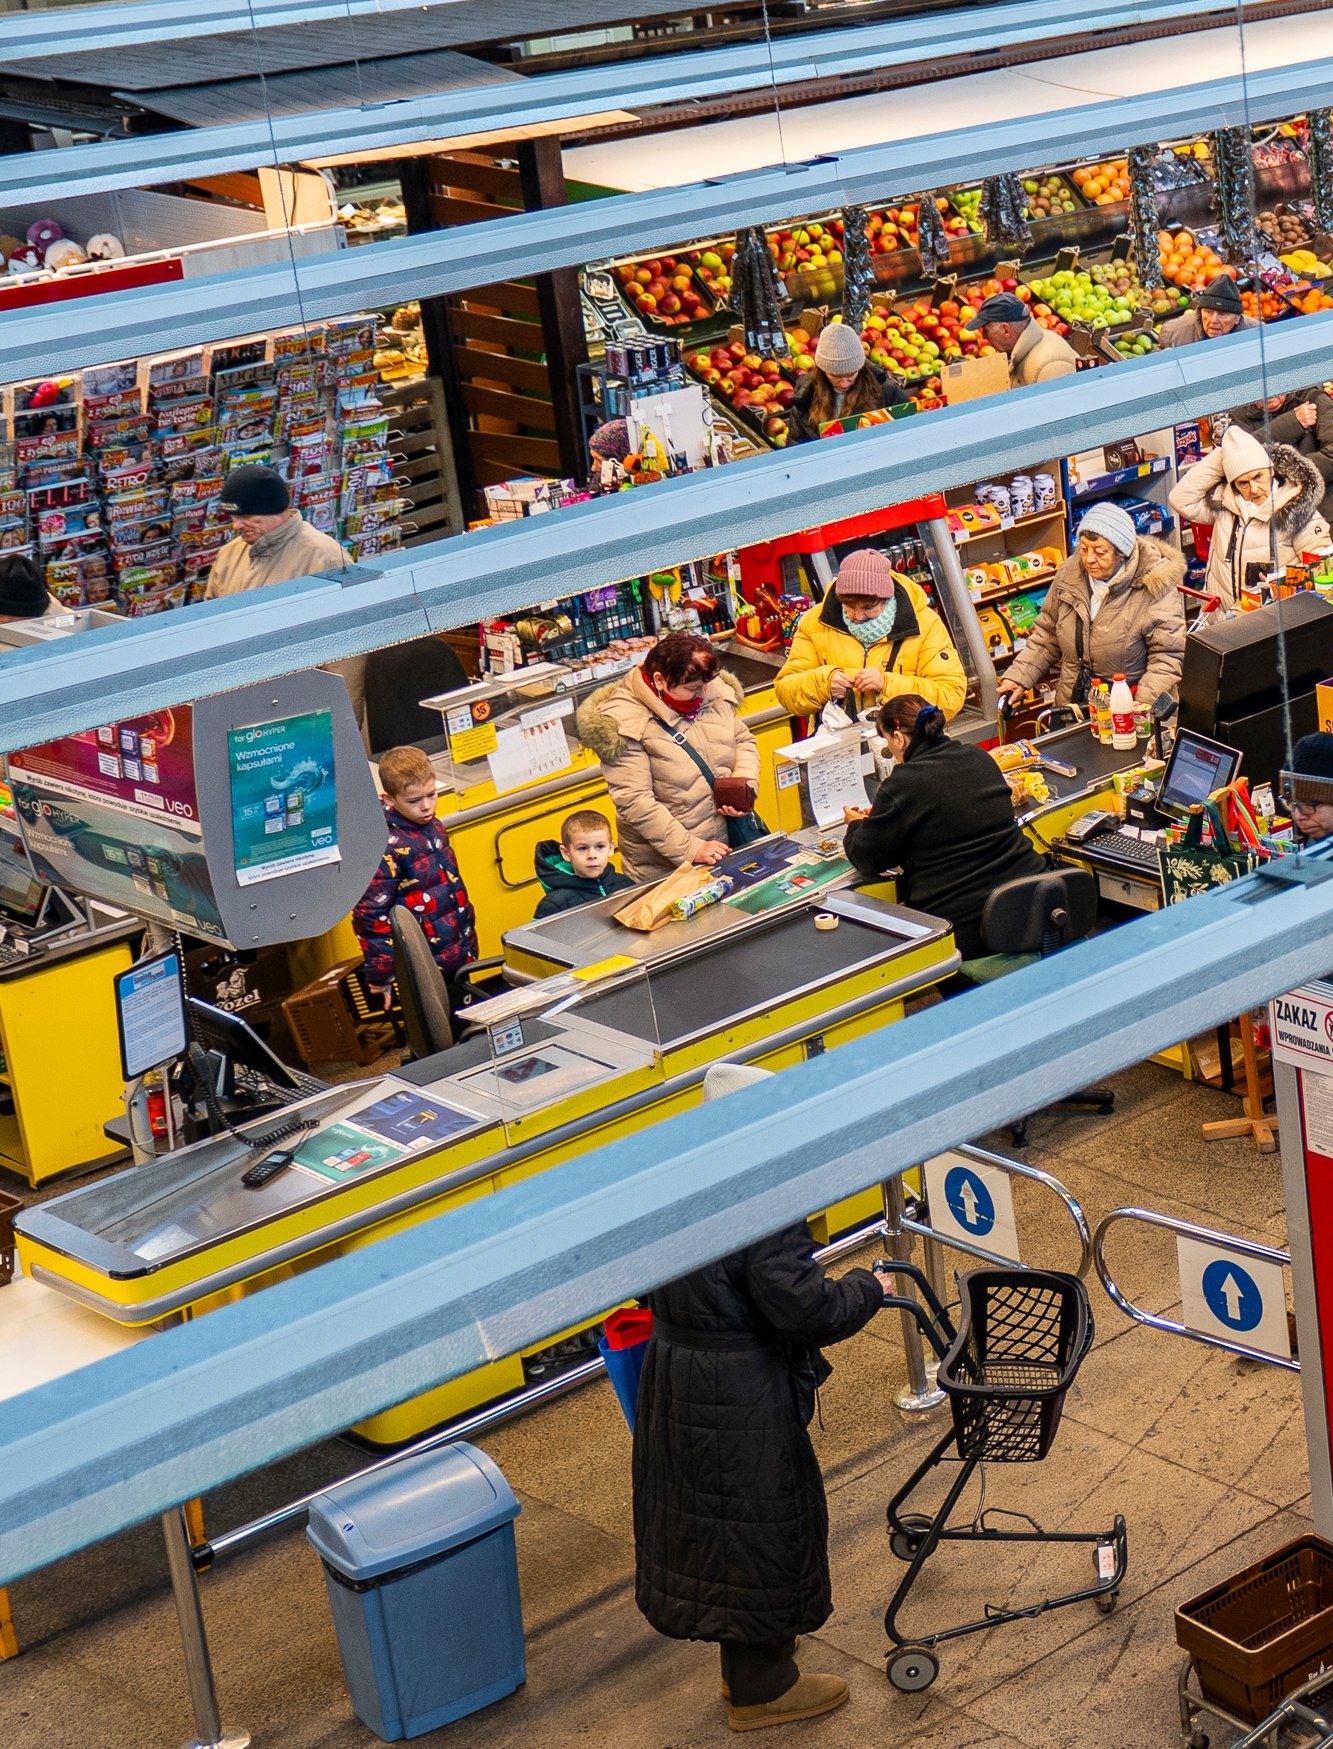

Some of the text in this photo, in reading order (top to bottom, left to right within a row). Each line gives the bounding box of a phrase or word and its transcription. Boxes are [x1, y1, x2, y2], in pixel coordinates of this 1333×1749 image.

[106, 472, 148, 491] RETRO
[234, 725, 286, 743] for glo HYPER
[236, 741, 296, 761] Wzmocnione
[236, 754, 283, 772] kapsułami
[43, 779, 64, 791] zawiera
[102, 796, 128, 812] powoduje
[18, 797, 31, 811] for
[31, 799, 51, 818] glo
[165, 798, 193, 818] veo
[311, 835, 333, 847] veo
[1275, 998, 1318, 1032] ZAKAZ
[1278, 1029, 1330, 1056] WPROWADZANIA
